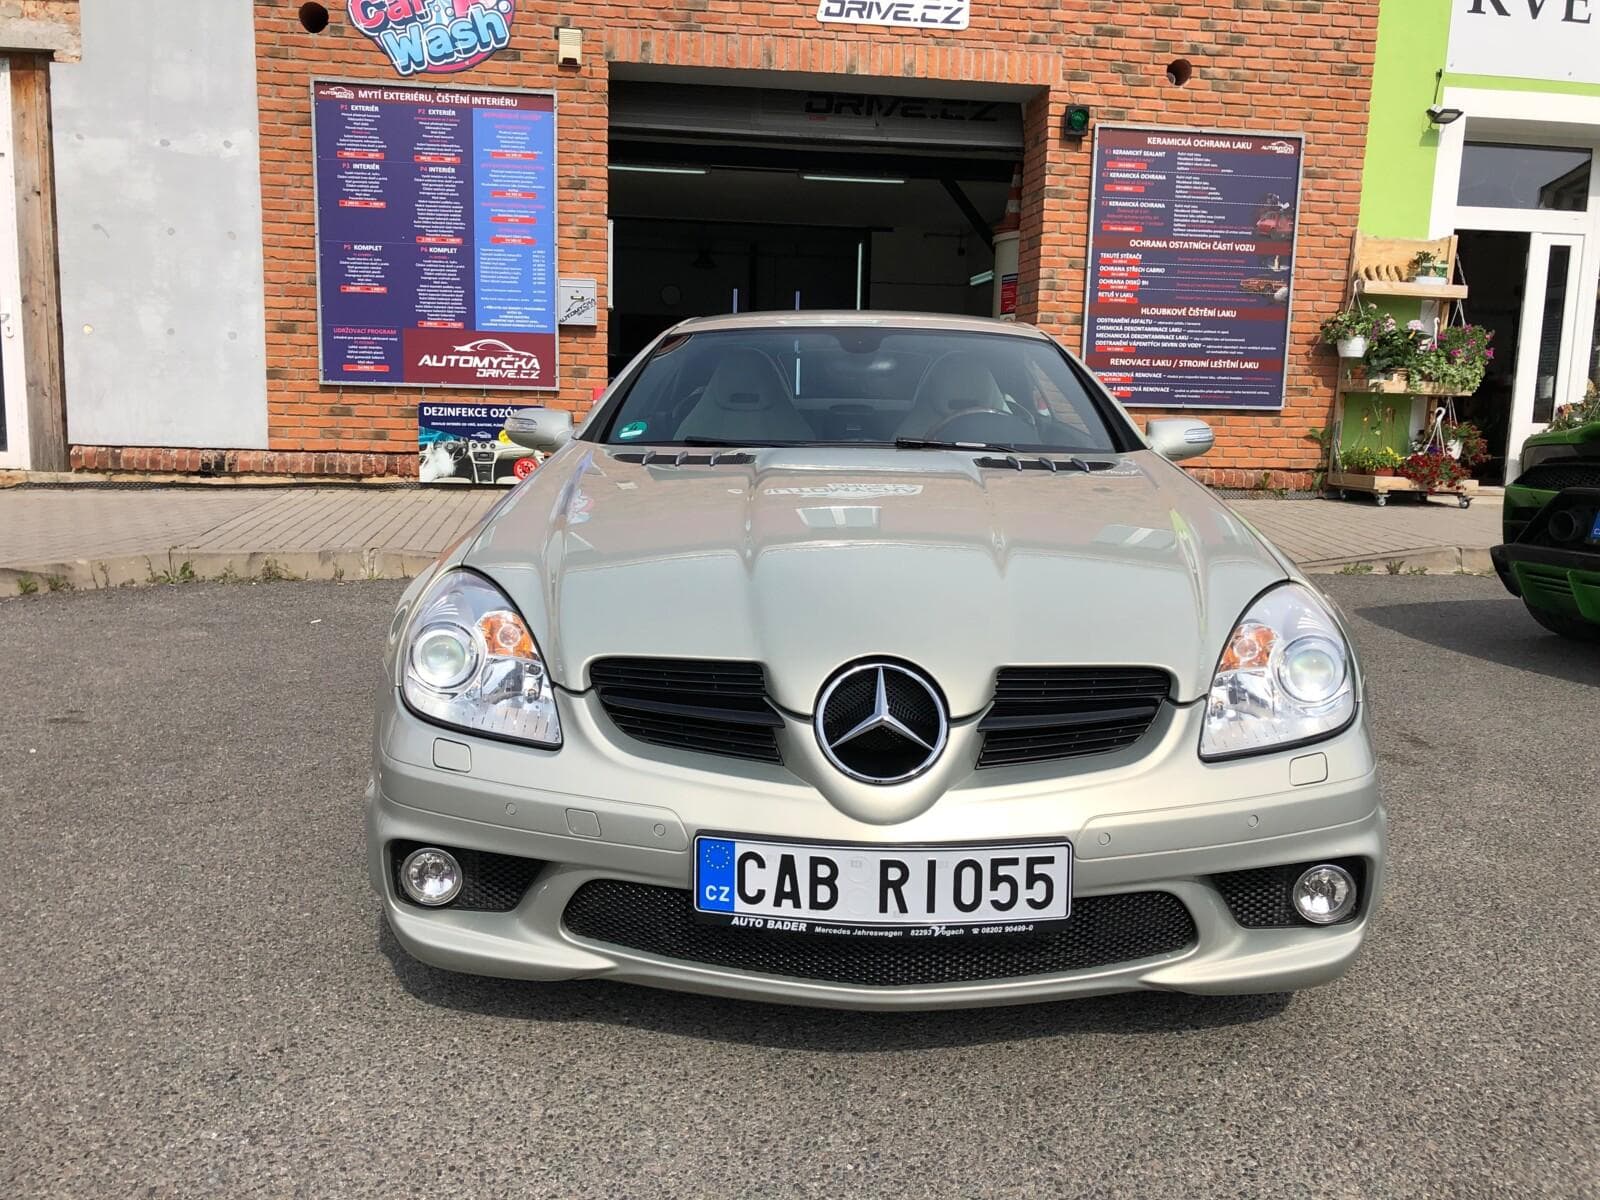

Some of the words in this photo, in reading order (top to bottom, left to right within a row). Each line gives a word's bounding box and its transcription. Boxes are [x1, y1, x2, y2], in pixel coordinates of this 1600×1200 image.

[824, 0, 964, 24] DRIVE.CZ
[382, 7, 508, 70] Wash
[358, 89, 381, 100] MYTÍ
[383, 91, 434, 104] EXTERIÉRU,
[436, 92, 470, 105] ČIŠTĚNÍ
[472, 95, 518, 107] INTERIÉRU
[350, 104, 379, 112] EXTERIÉR
[428, 108, 456, 116] EXTERIÉR
[1147, 136, 1192, 147] KERAMICKÁ
[1193, 139, 1231, 149] OCHRANA
[1232, 141, 1252, 150] LAKU
[352, 162, 380, 170] INTERIÉR
[1129, 239, 1167, 249] OCHRANA
[1168, 240, 1211, 250] OSTATNÍCH
[1212, 241, 1233, 251] ČÁSTÍ
[1234, 243, 1255, 252] VOZU
[1141, 306, 1187, 316] HLOUBKOVÉ
[1188, 307, 1216, 317] ČIŠTĚNÍ
[1217, 310, 1237, 318] LAKU
[418, 354, 540, 369] AUTOMYČKA
[1110, 358, 1151, 367] RENOVACE
[1152, 359, 1171, 367] LAKU
[1178, 359, 1210, 369] STROJNÍ
[1210, 359, 1239, 369] LEŠTĚNÍ
[1240, 361, 1259, 369] LAKU
[476, 368, 540, 379] DRIVE.CZ
[423, 406, 488, 417] DEZINFEKCE
[490, 407, 518, 418] OZÓ
[737, 850, 839, 911] CAB
[704, 885, 730, 901] CZ
[731, 917, 764, 928] AUTO
[766, 920, 807, 932] BADER
[814, 926, 850, 935] Mercedes
[853, 928, 903, 937] Jahreswagen
